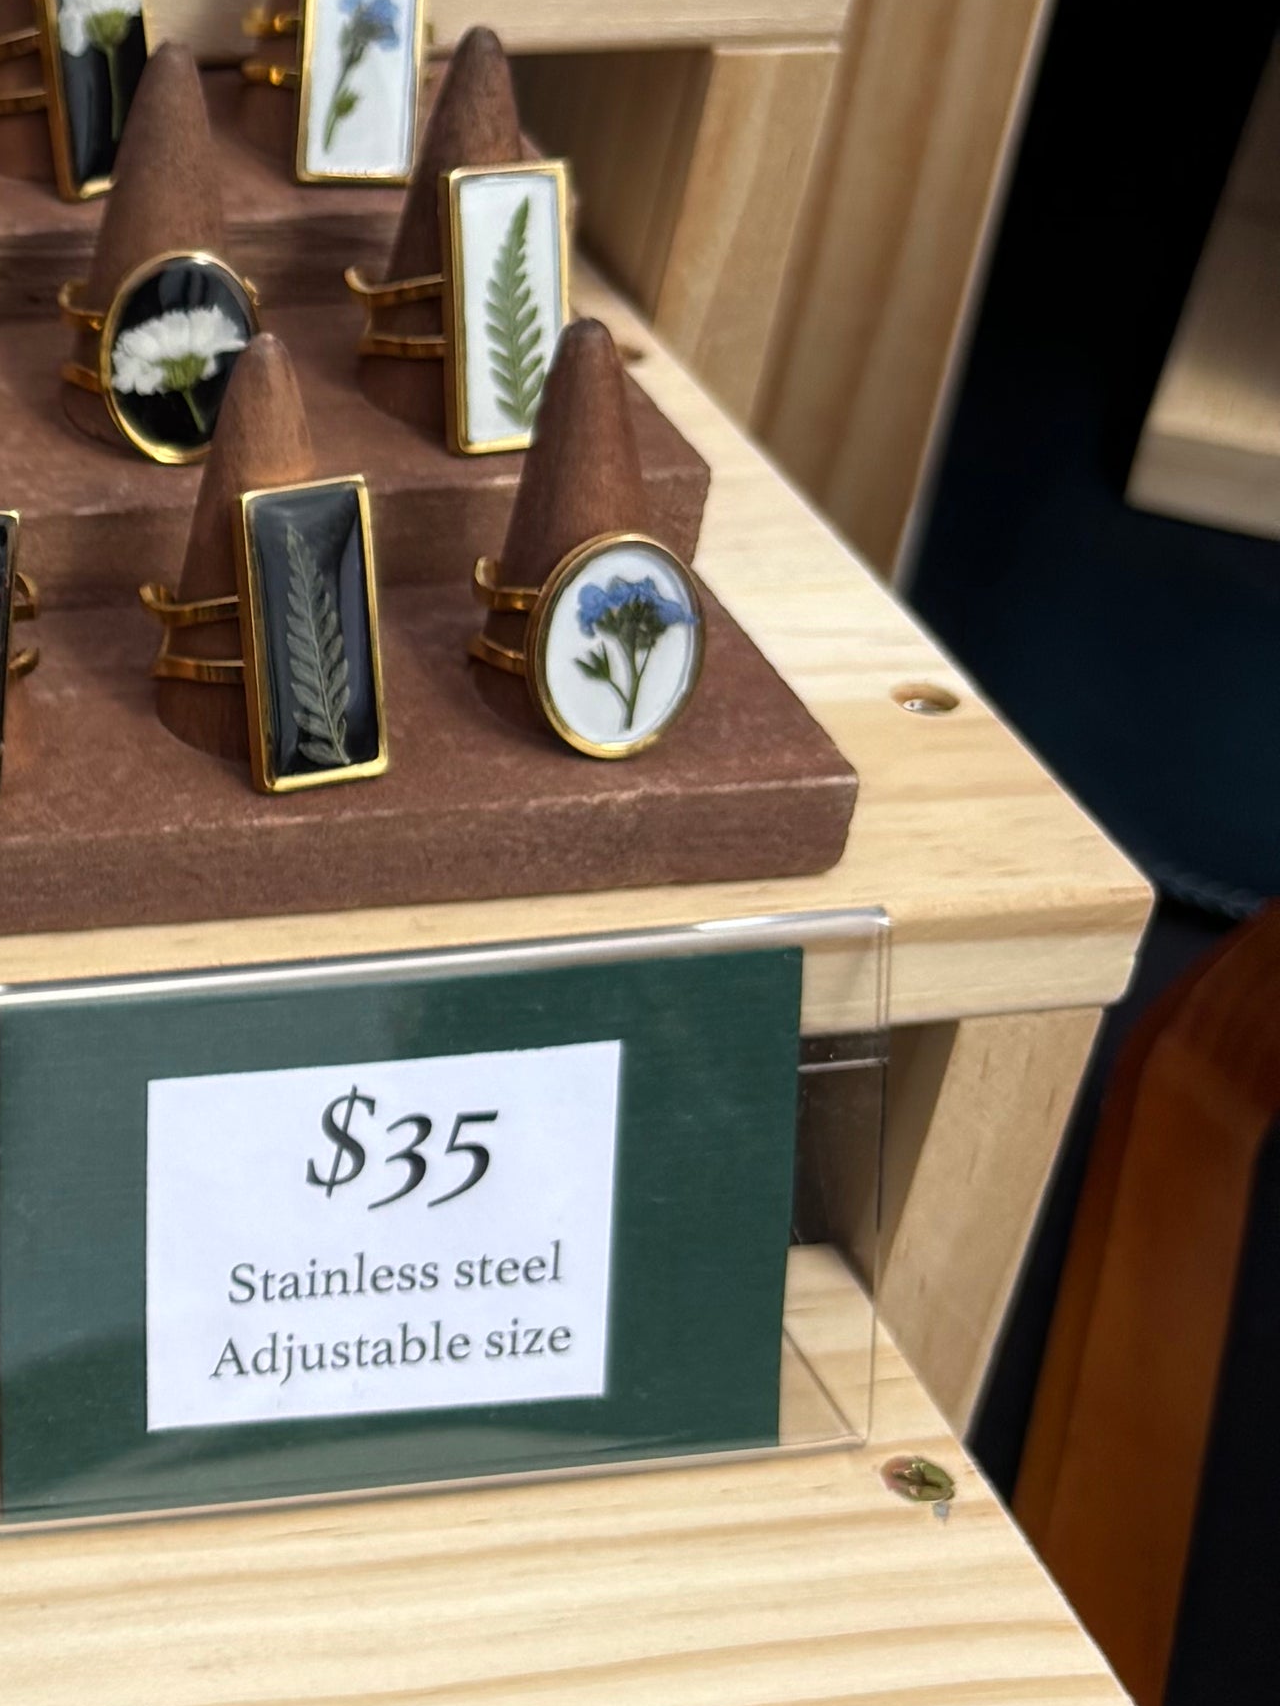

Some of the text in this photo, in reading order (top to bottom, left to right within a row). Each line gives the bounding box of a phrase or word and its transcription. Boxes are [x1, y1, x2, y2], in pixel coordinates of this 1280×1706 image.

[305, 1084, 499, 1211] $35
[228, 1239, 563, 1304] Stainless steel
[208, 1317, 573, 1385] Adjustable size
